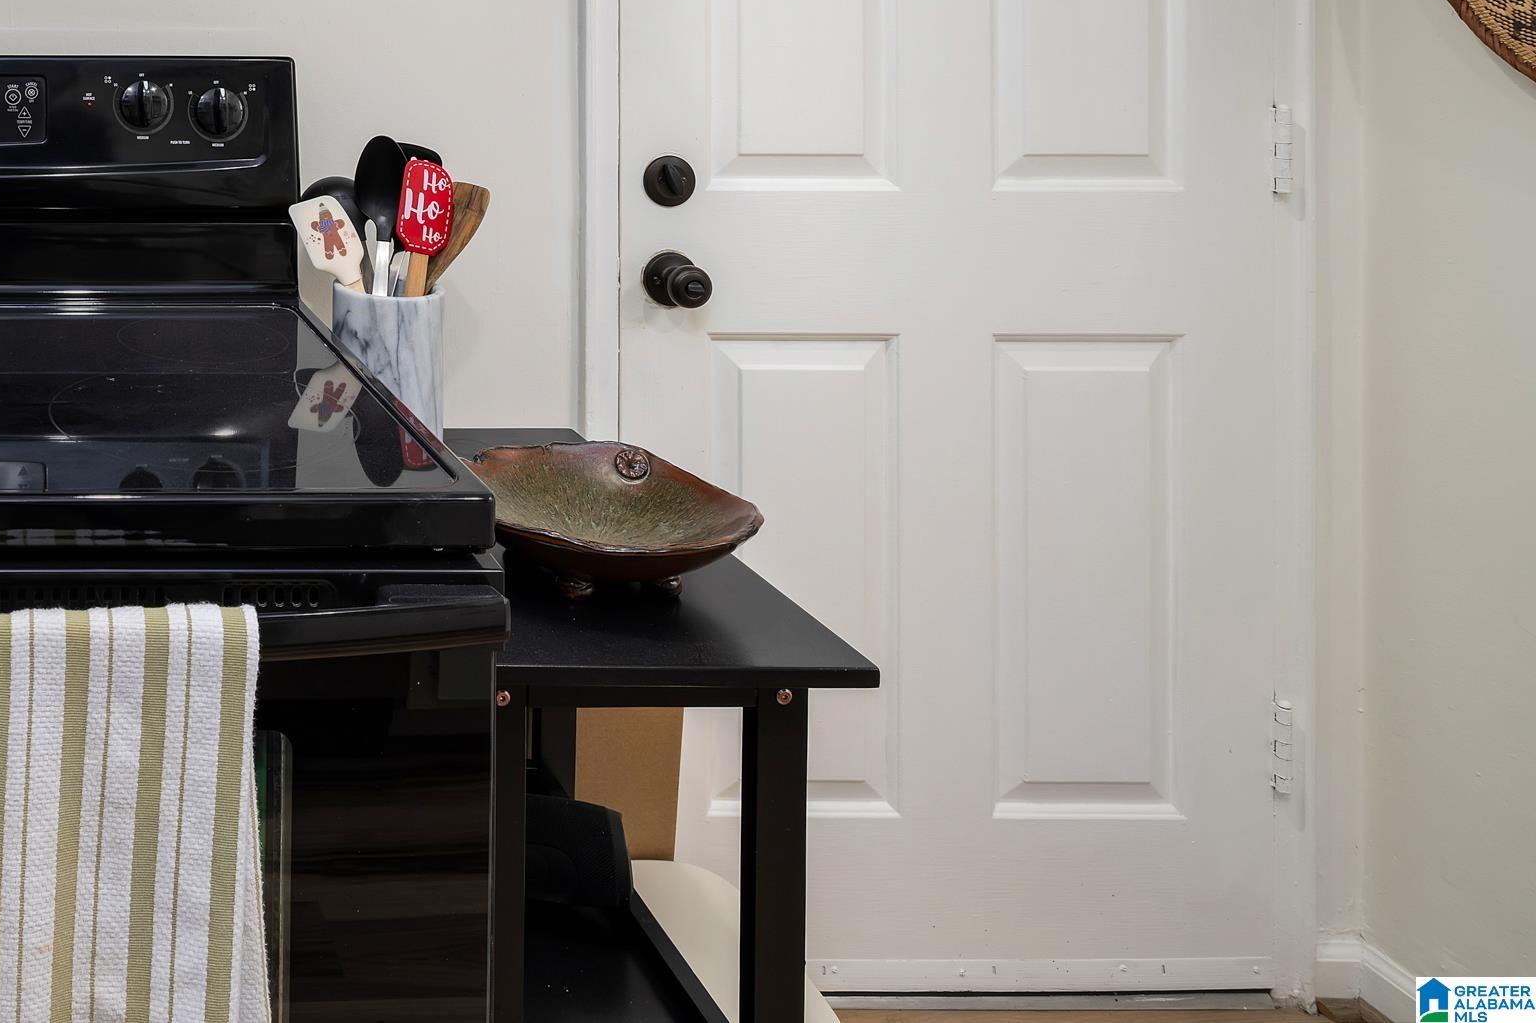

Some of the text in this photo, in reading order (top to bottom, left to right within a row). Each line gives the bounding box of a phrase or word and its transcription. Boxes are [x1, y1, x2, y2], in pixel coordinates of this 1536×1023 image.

[423, 169, 450, 194] Ho
[404, 188, 444, 225] Ho
[422, 225, 442, 244] Ho
